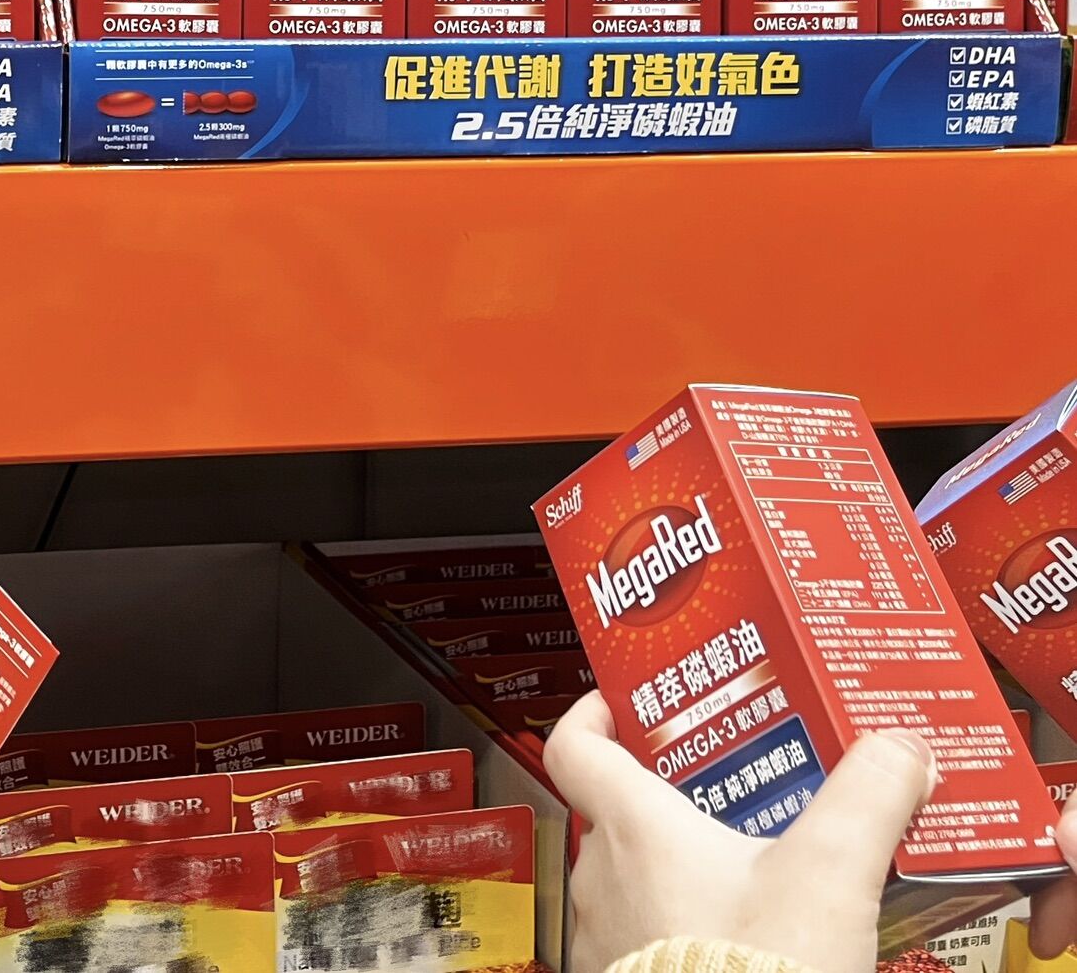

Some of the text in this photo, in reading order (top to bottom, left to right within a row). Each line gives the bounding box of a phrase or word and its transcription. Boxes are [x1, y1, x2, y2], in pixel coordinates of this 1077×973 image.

[270, 20, 383, 34] OMEGA-3 軟膠囊
[969, 46, 1015, 64] DHA
[384, 52, 799, 100] 促進代謝 打造好氣色
[967, 70, 1014, 88] EPA
[965, 92, 1019, 111] 蝦紅素
[451, 102, 737, 140] 2.5倍純淨磷蝦油
[965, 116, 1017, 134] 磷脂質
[546, 484, 581, 528] Schiff
[440, 562, 515, 579] WEIDER
[586, 495, 722, 629] MegaRed
[979, 535, 1077, 635] MegaR
[481, 594, 559, 612] WEIDER
[526, 631, 579, 647] WEID
[631, 620, 765, 728] 精萃磷蝦油
[685, 688, 733, 729] 750mg
[307, 723, 401, 749] WEIDER
[656, 685, 787, 779] OMEGA-3 軟膠囊
[71, 744, 169, 767] WEIDER
